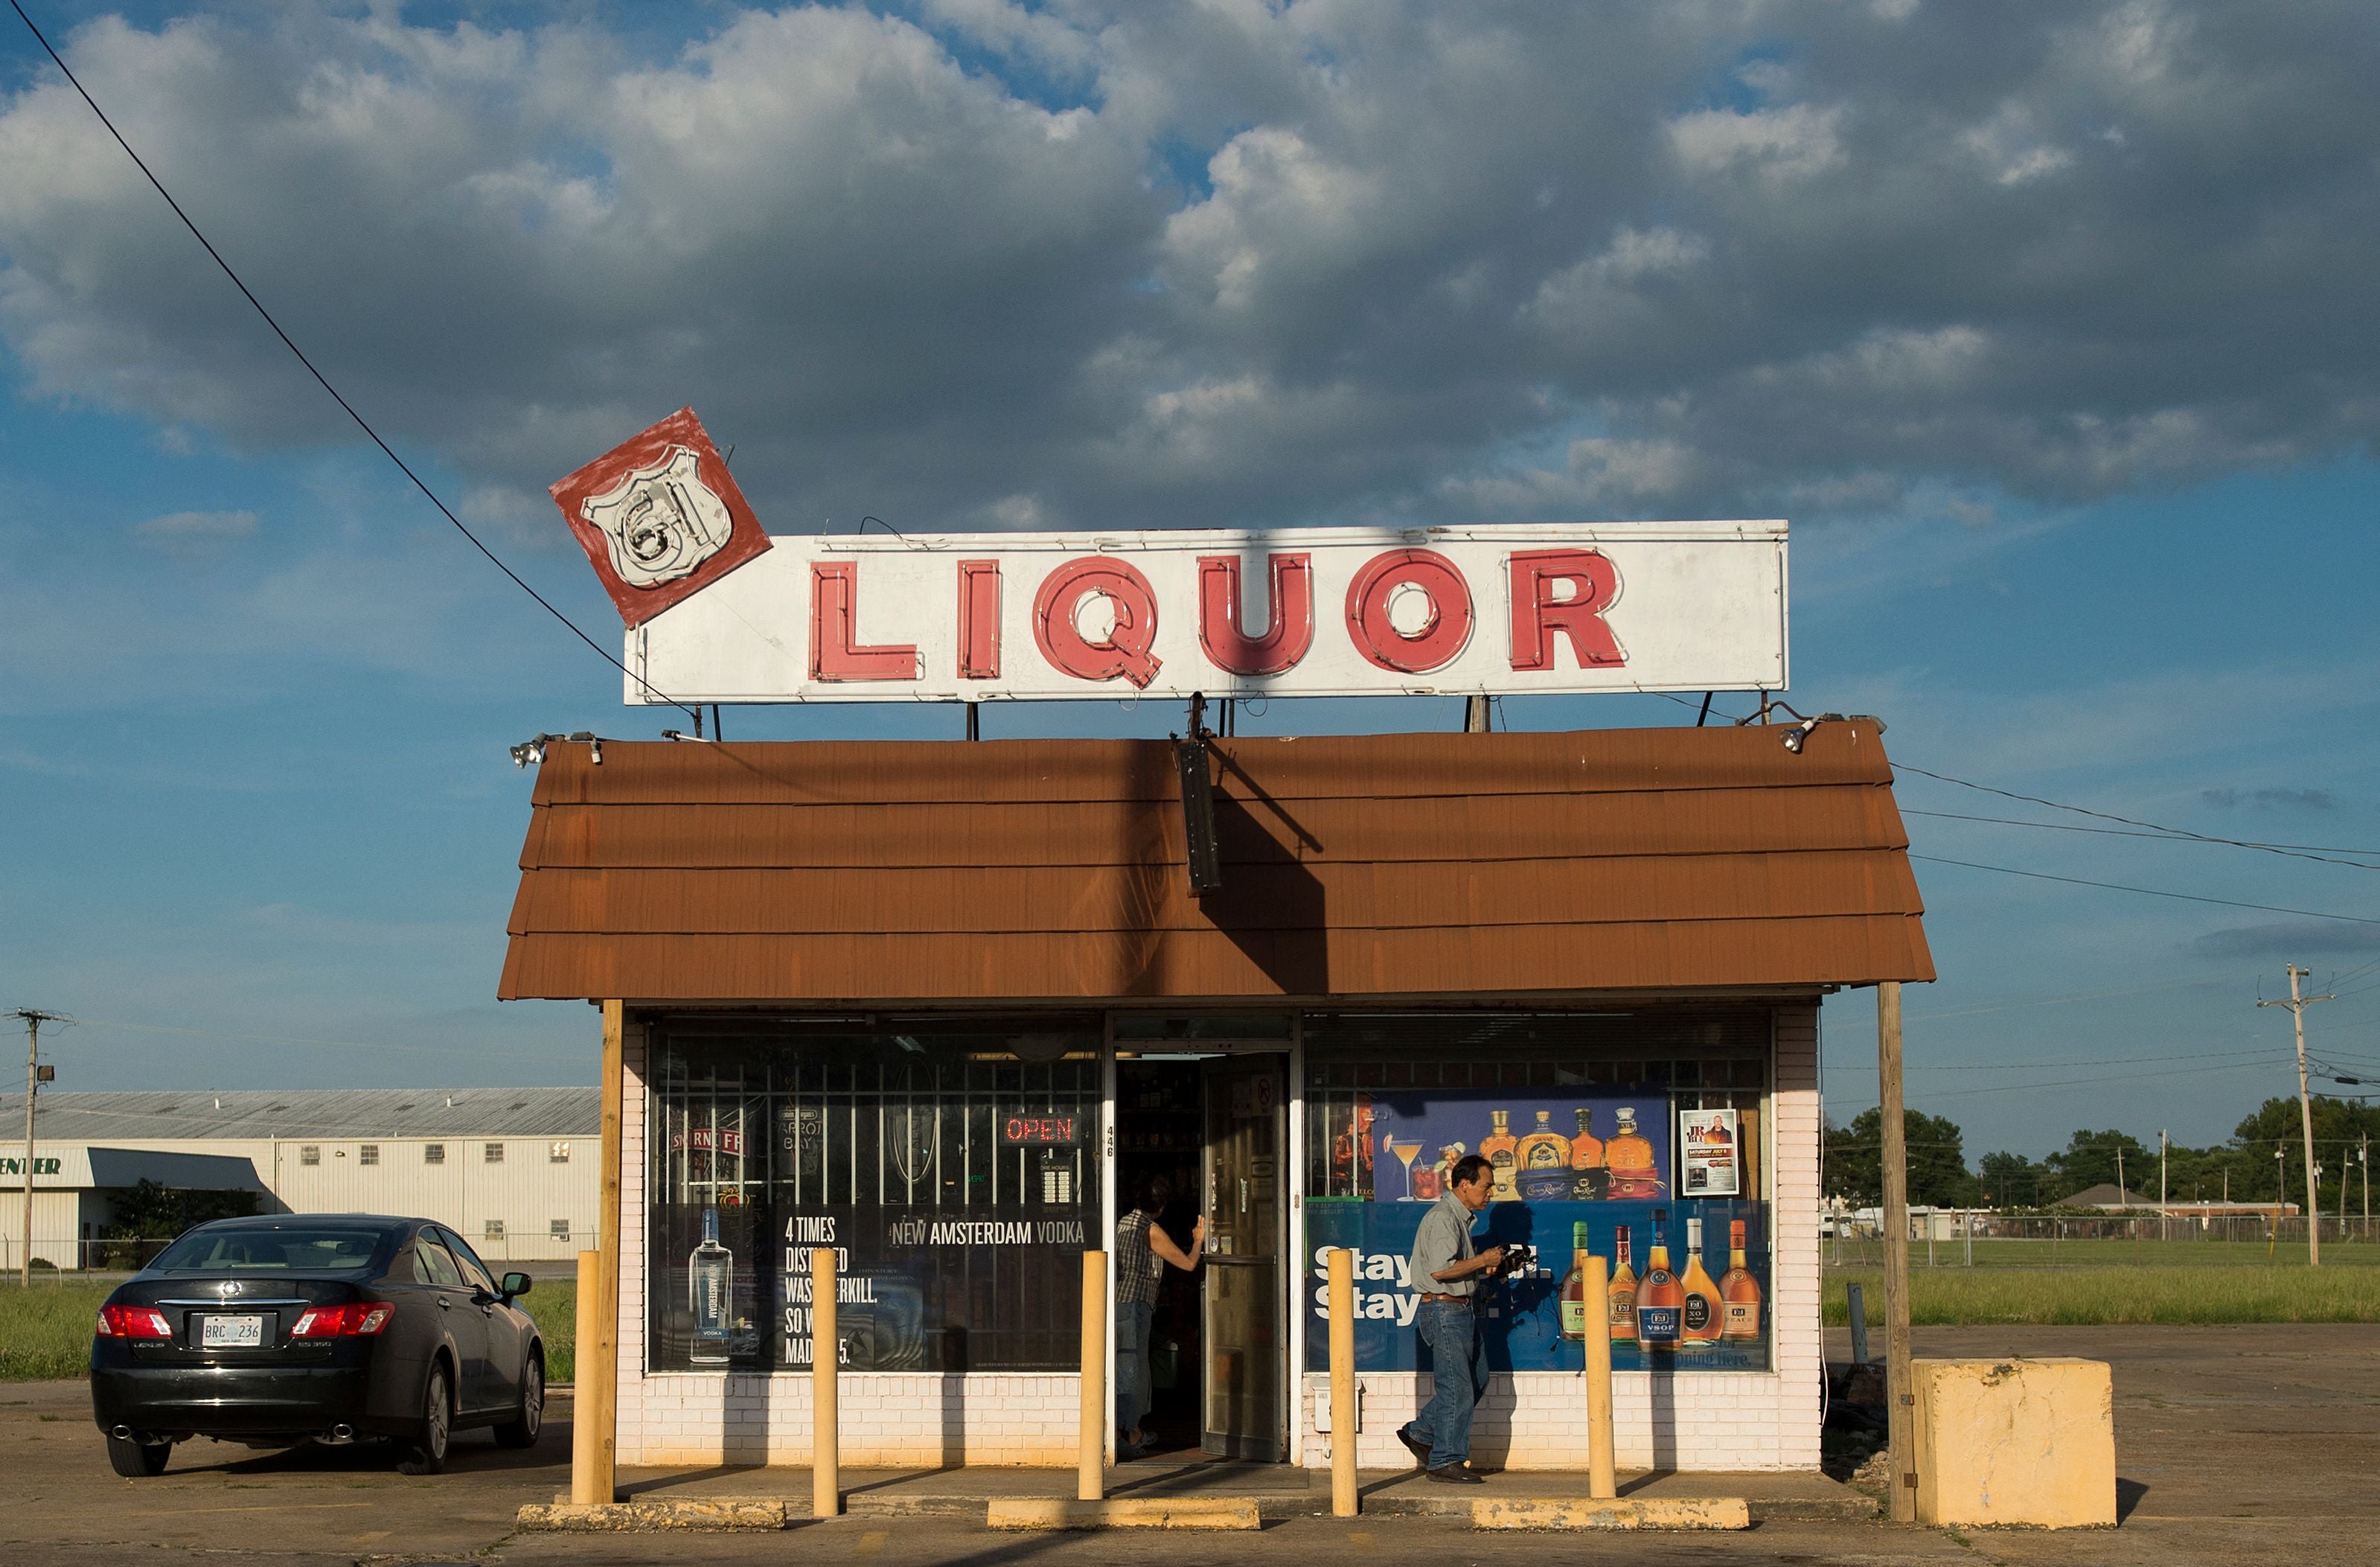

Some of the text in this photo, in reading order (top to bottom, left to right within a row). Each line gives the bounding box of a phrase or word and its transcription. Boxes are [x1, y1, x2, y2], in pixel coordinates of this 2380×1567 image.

[613, 474, 707, 567] 61
[808, 549, 1627, 689] LIQUOR
[674, 1132, 743, 1151] SRNFF
[1007, 1118, 1072, 1140] OPEN
[785, 1217, 836, 1242] 4 TIMES
[892, 1221, 1084, 1245] NEW AMSTERDAM VODKA
[786, 1247, 848, 1273] DISTD
[708, 1279, 718, 1318] AMSTERDAM
[786, 1277, 813, 1303] WAS
[205, 1325, 259, 1338] BRC 236
[785, 1308, 799, 1333] SO
[786, 1338, 850, 1364] MAD 5.
